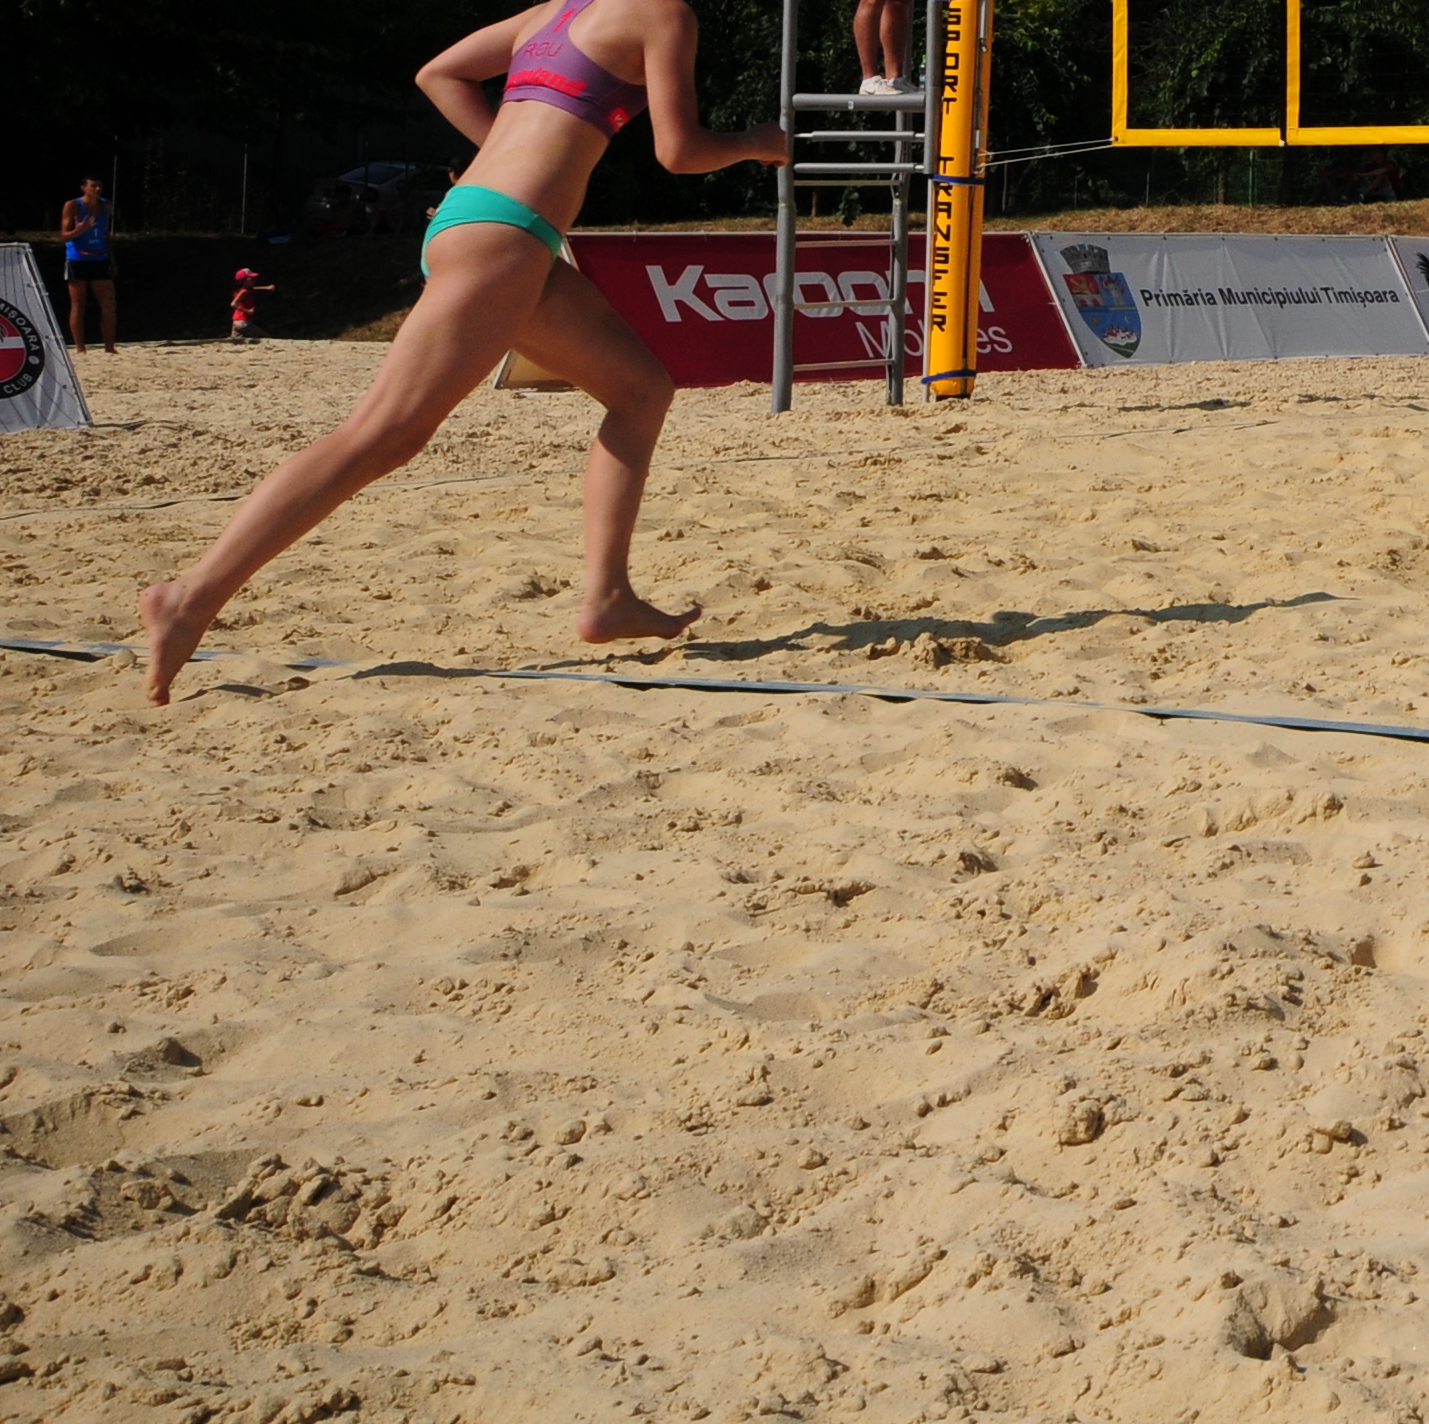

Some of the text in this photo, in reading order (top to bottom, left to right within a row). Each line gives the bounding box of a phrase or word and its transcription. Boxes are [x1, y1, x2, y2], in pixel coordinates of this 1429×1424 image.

[1140, 287, 1217, 308] Primăria
[1219, 286, 1322, 309] Municipiului
[3, 373, 33, 395] CLUB
